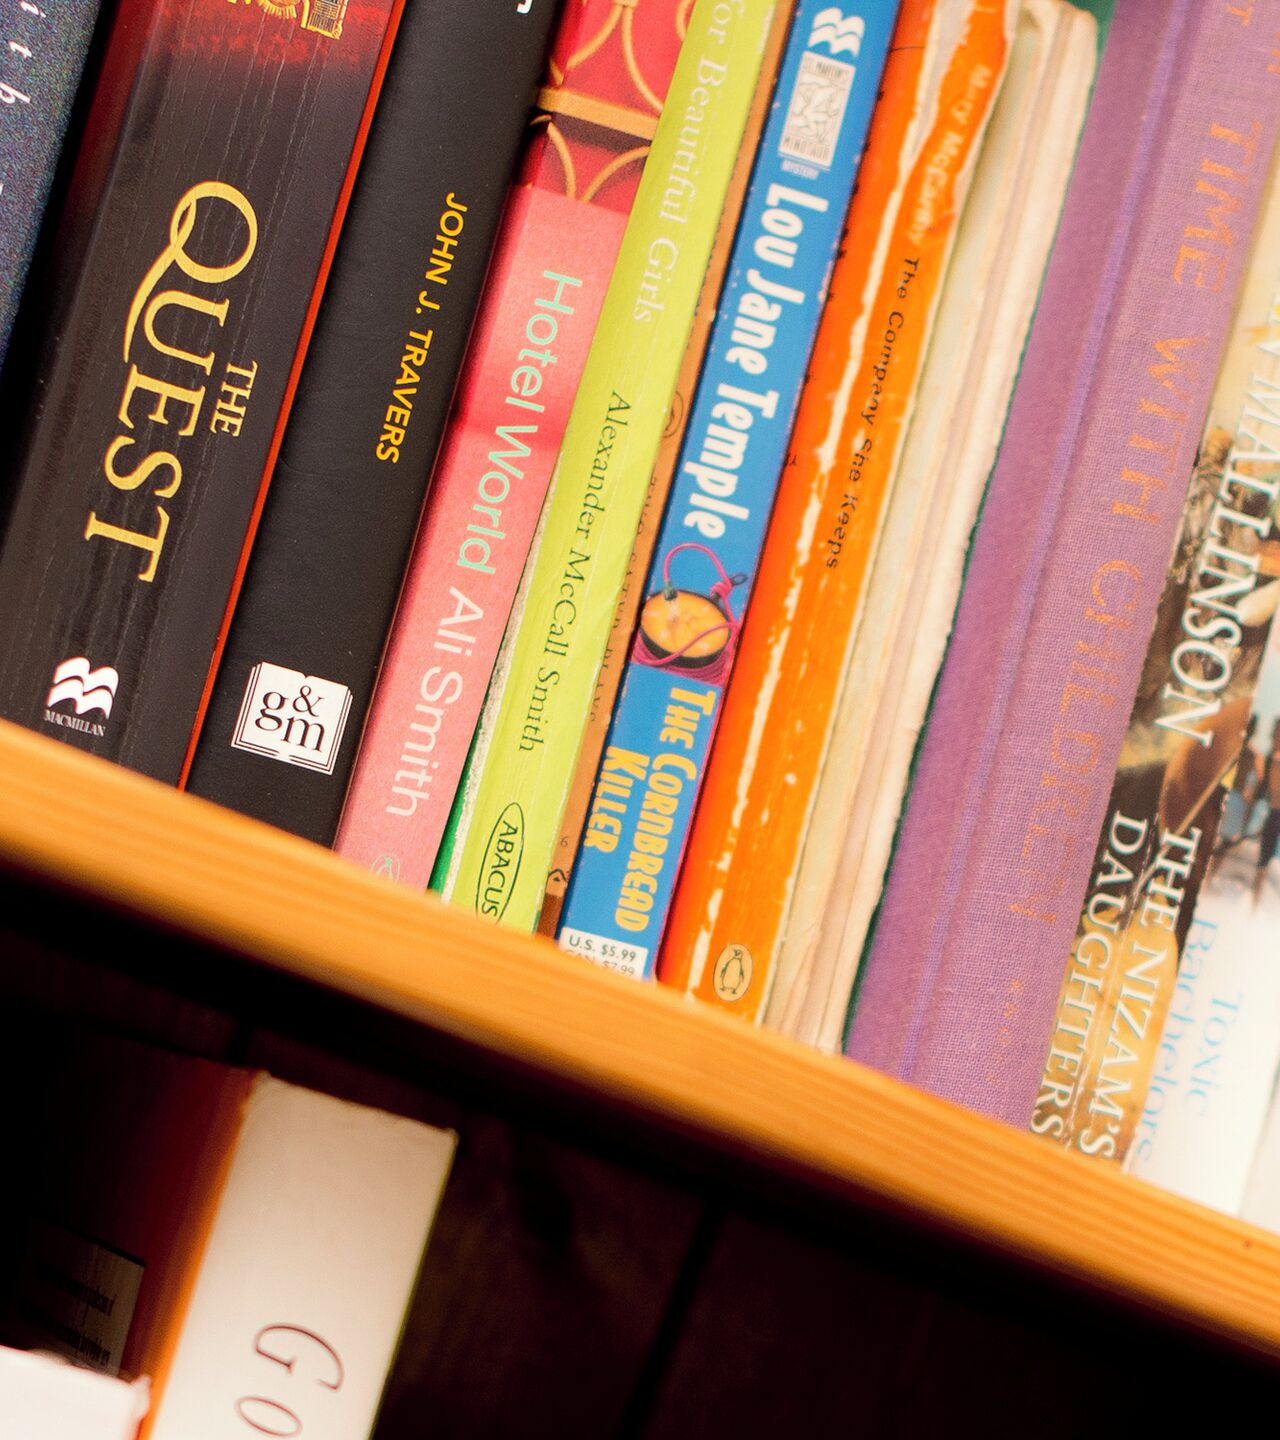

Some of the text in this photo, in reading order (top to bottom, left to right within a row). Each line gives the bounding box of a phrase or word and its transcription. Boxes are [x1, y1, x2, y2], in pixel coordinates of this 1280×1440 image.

[633, 55, 728, 325] Beautiful Girls
[1110, 119, 1265, 526] TIME WITH
[83, 179, 259, 583] QUEST
[210, 360, 258, 437] THE
[375, 192, 468, 464] JOHN TRAVERS
[683, 183, 829, 539] Lou Jane Temple
[825, 256, 920, 571] The Company She Keeps
[390, 269, 583, 820] Hotel World Ali Smith
[544, 547, 591, 655] McCall
[575, 391, 632, 540] Alexander
[43, 708, 106, 737] MACMILLAN
[519, 668, 561, 752] Smith
[480, 820, 518, 918] ABACUS
[1029, 809, 1148, 1139] DAUGHTERS
[1079, 825, 1203, 1161] THE NIZAM'S
